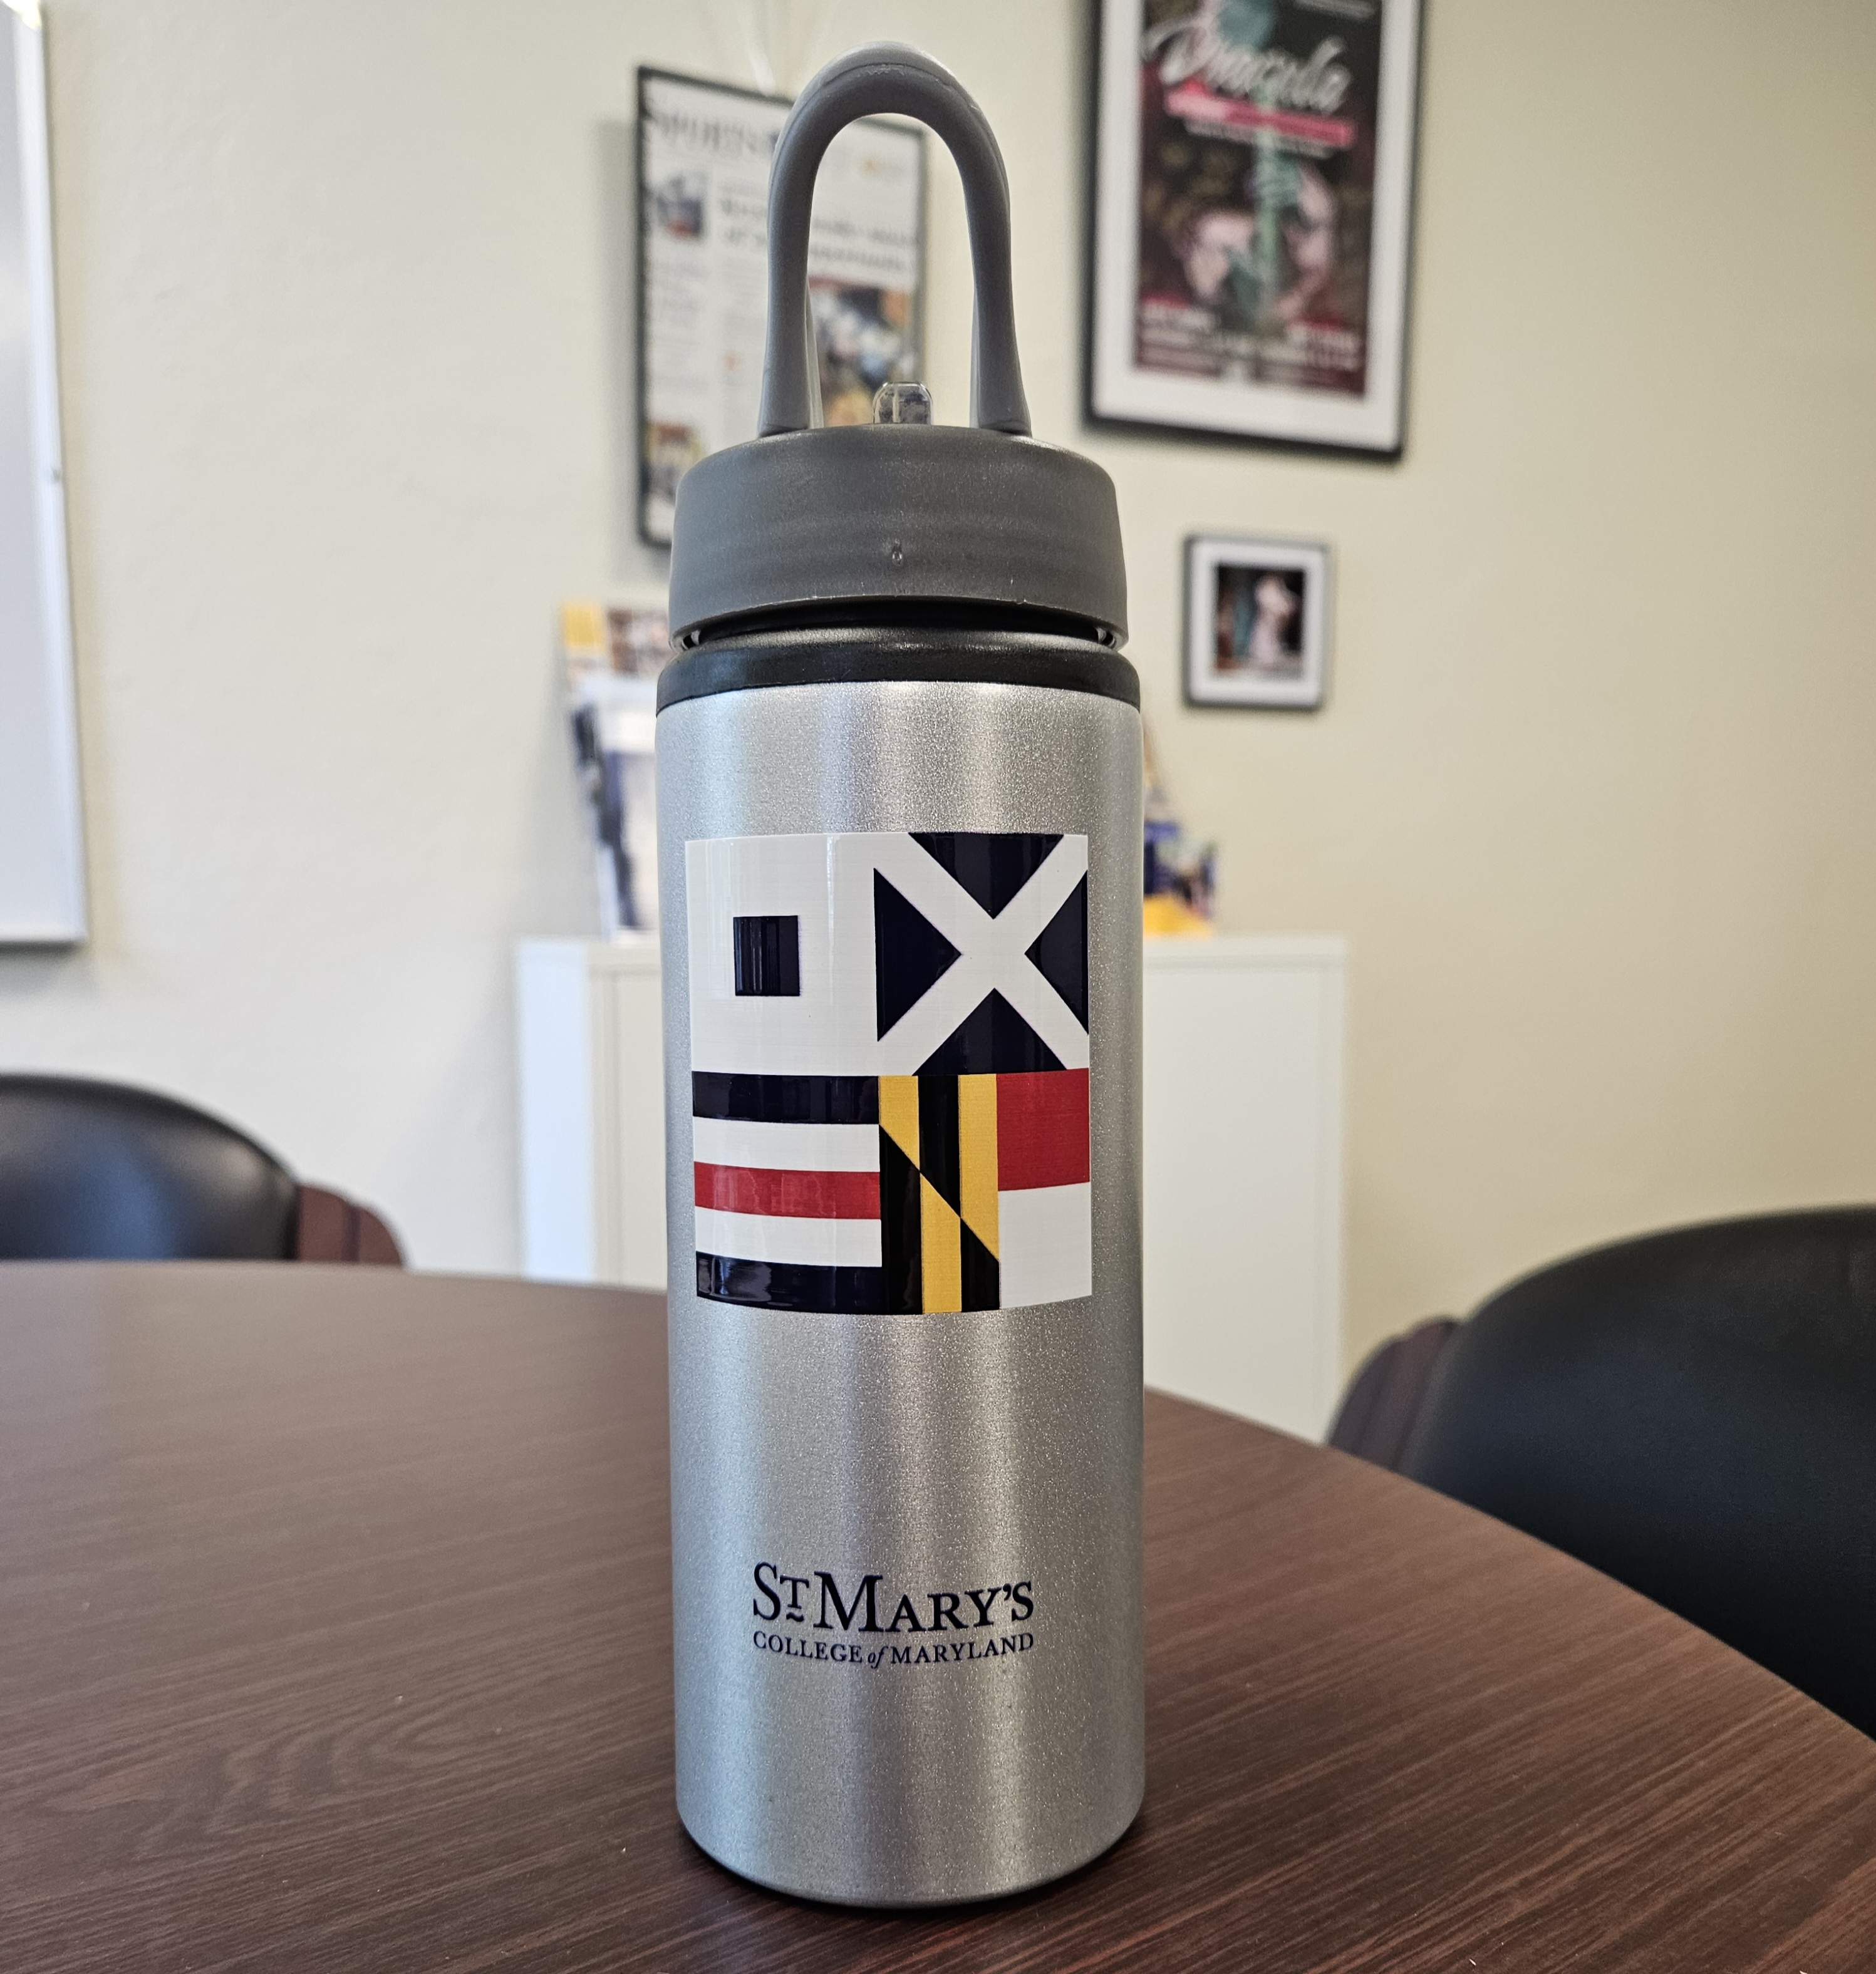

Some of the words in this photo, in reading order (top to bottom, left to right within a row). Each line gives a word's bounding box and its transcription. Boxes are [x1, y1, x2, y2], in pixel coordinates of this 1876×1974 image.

[813, 1570, 1034, 1632] MARY'S
[753, 1630, 863, 1663] COLLEGE
[867, 1645, 888, 1668] of
[891, 1632, 1034, 1664] MARYLAND
